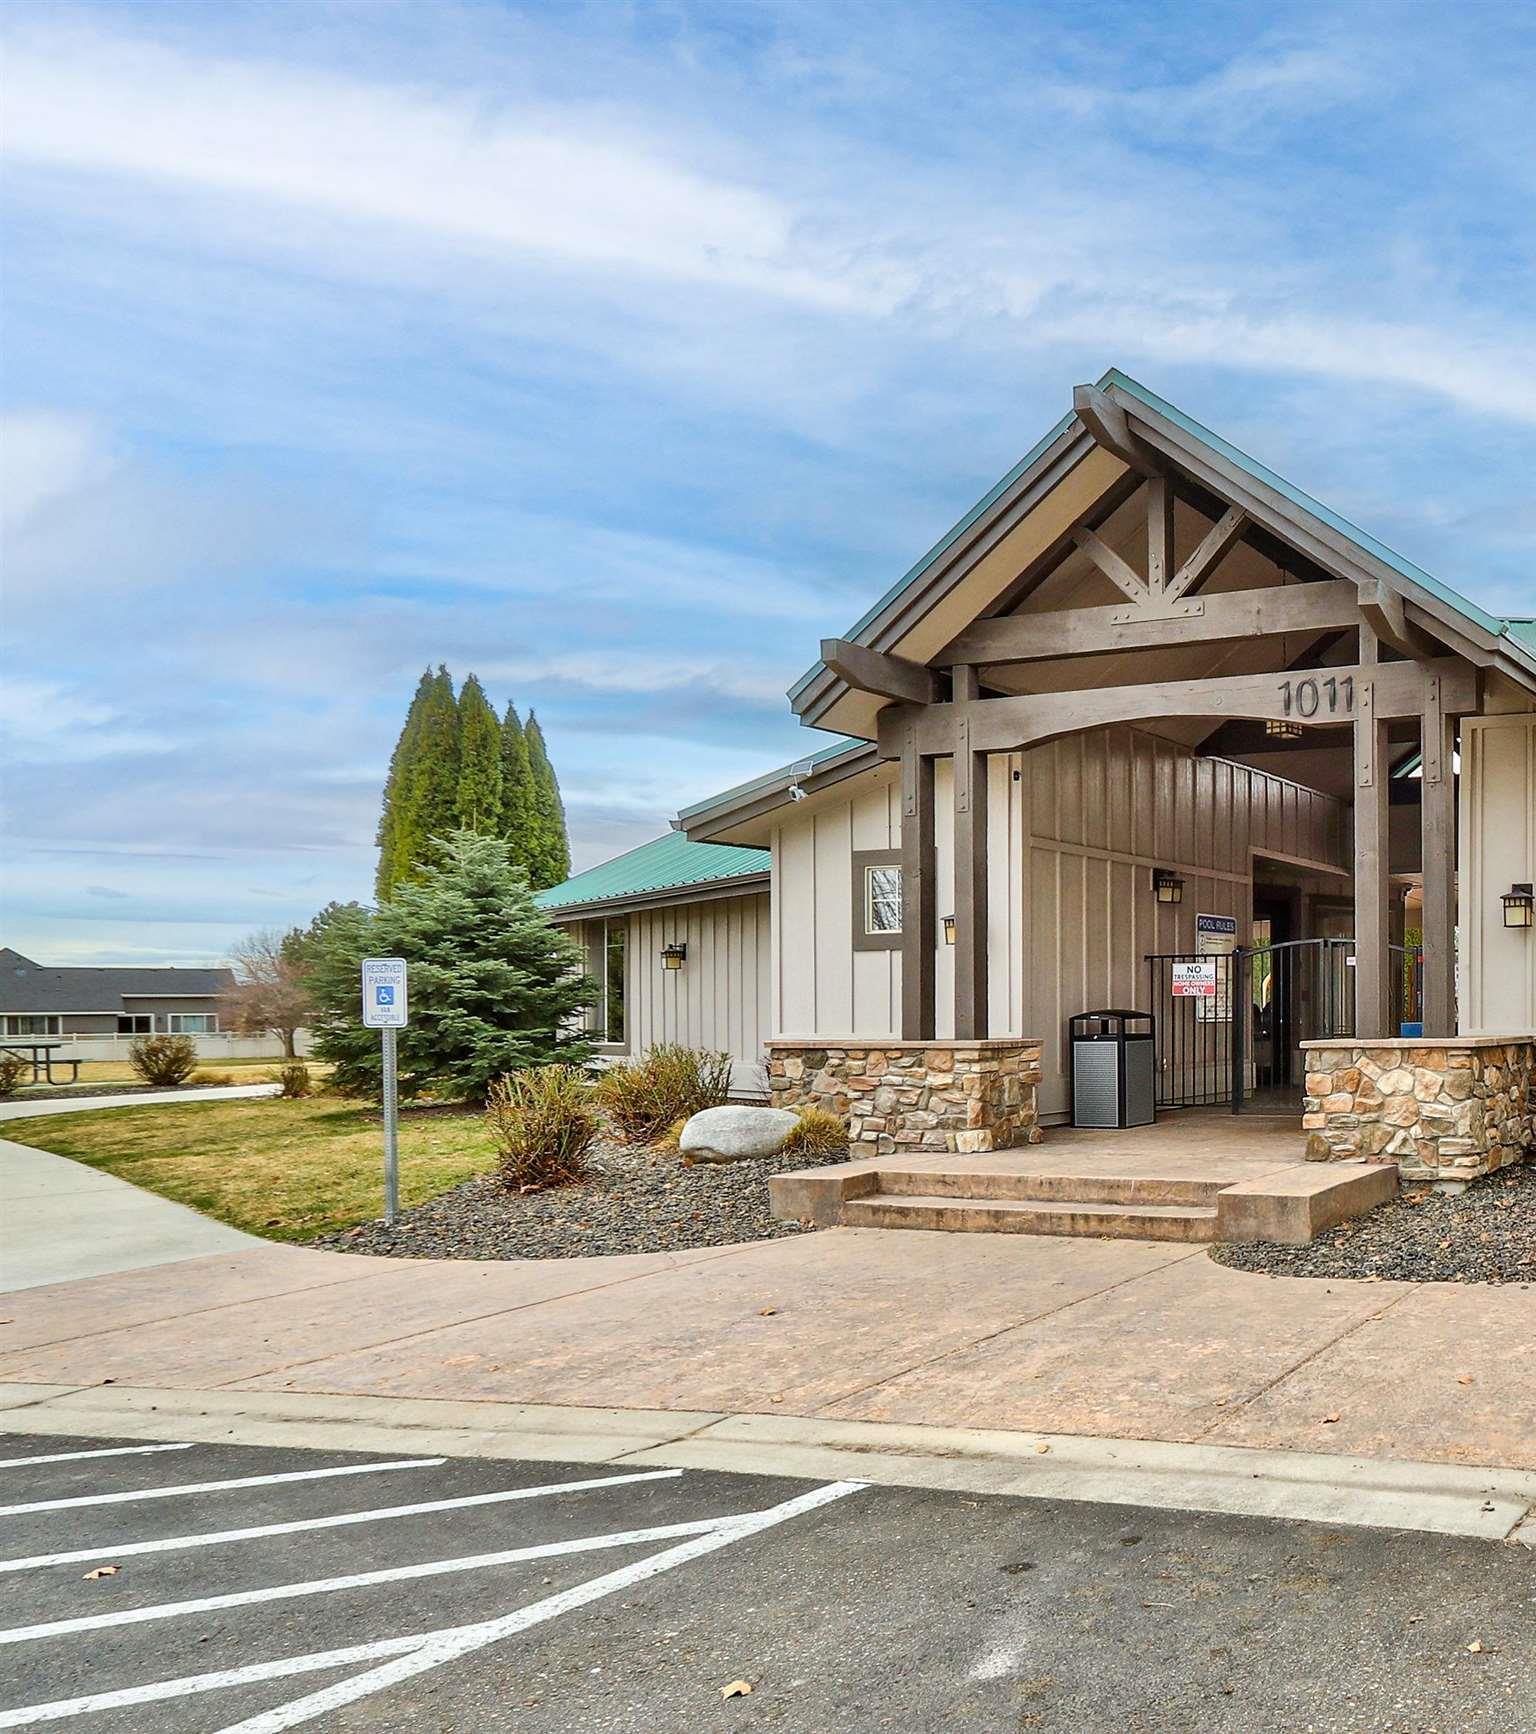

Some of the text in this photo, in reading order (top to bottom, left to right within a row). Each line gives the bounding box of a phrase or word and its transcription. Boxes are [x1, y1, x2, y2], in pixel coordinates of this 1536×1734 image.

[1277, 675, 1354, 718] 1011
[1199, 919, 1234, 931] POOL RULES
[367, 964, 402, 973] RESERVED
[368, 976, 401, 985] PARKING
[1183, 986, 1205, 994] ONLY
